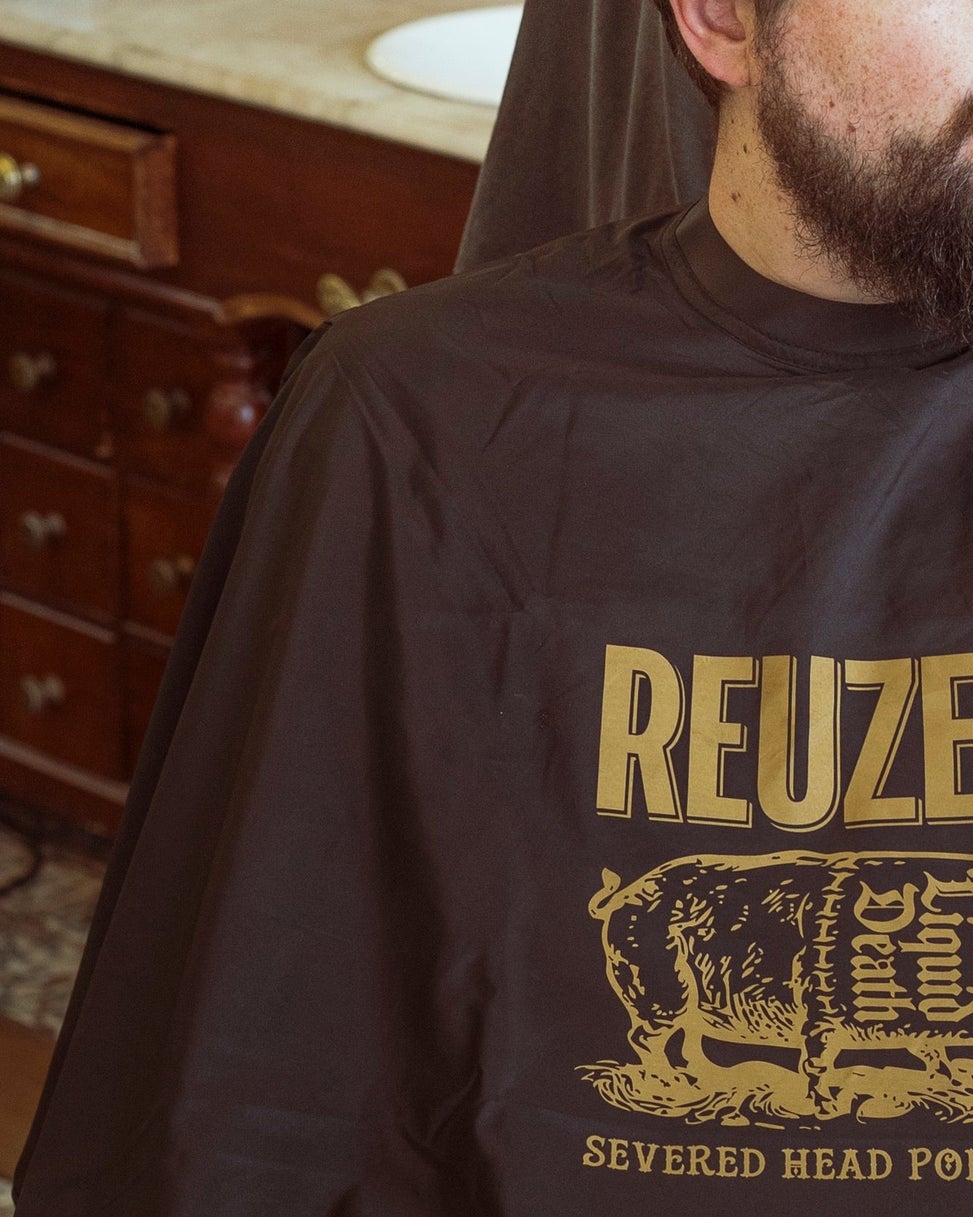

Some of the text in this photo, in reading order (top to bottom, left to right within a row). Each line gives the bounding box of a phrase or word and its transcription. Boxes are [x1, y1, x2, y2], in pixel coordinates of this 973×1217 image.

[854, 879, 923, 1024] Death
[582, 1134, 766, 1181] SEVERED
[781, 1146, 893, 1181] HEAD
